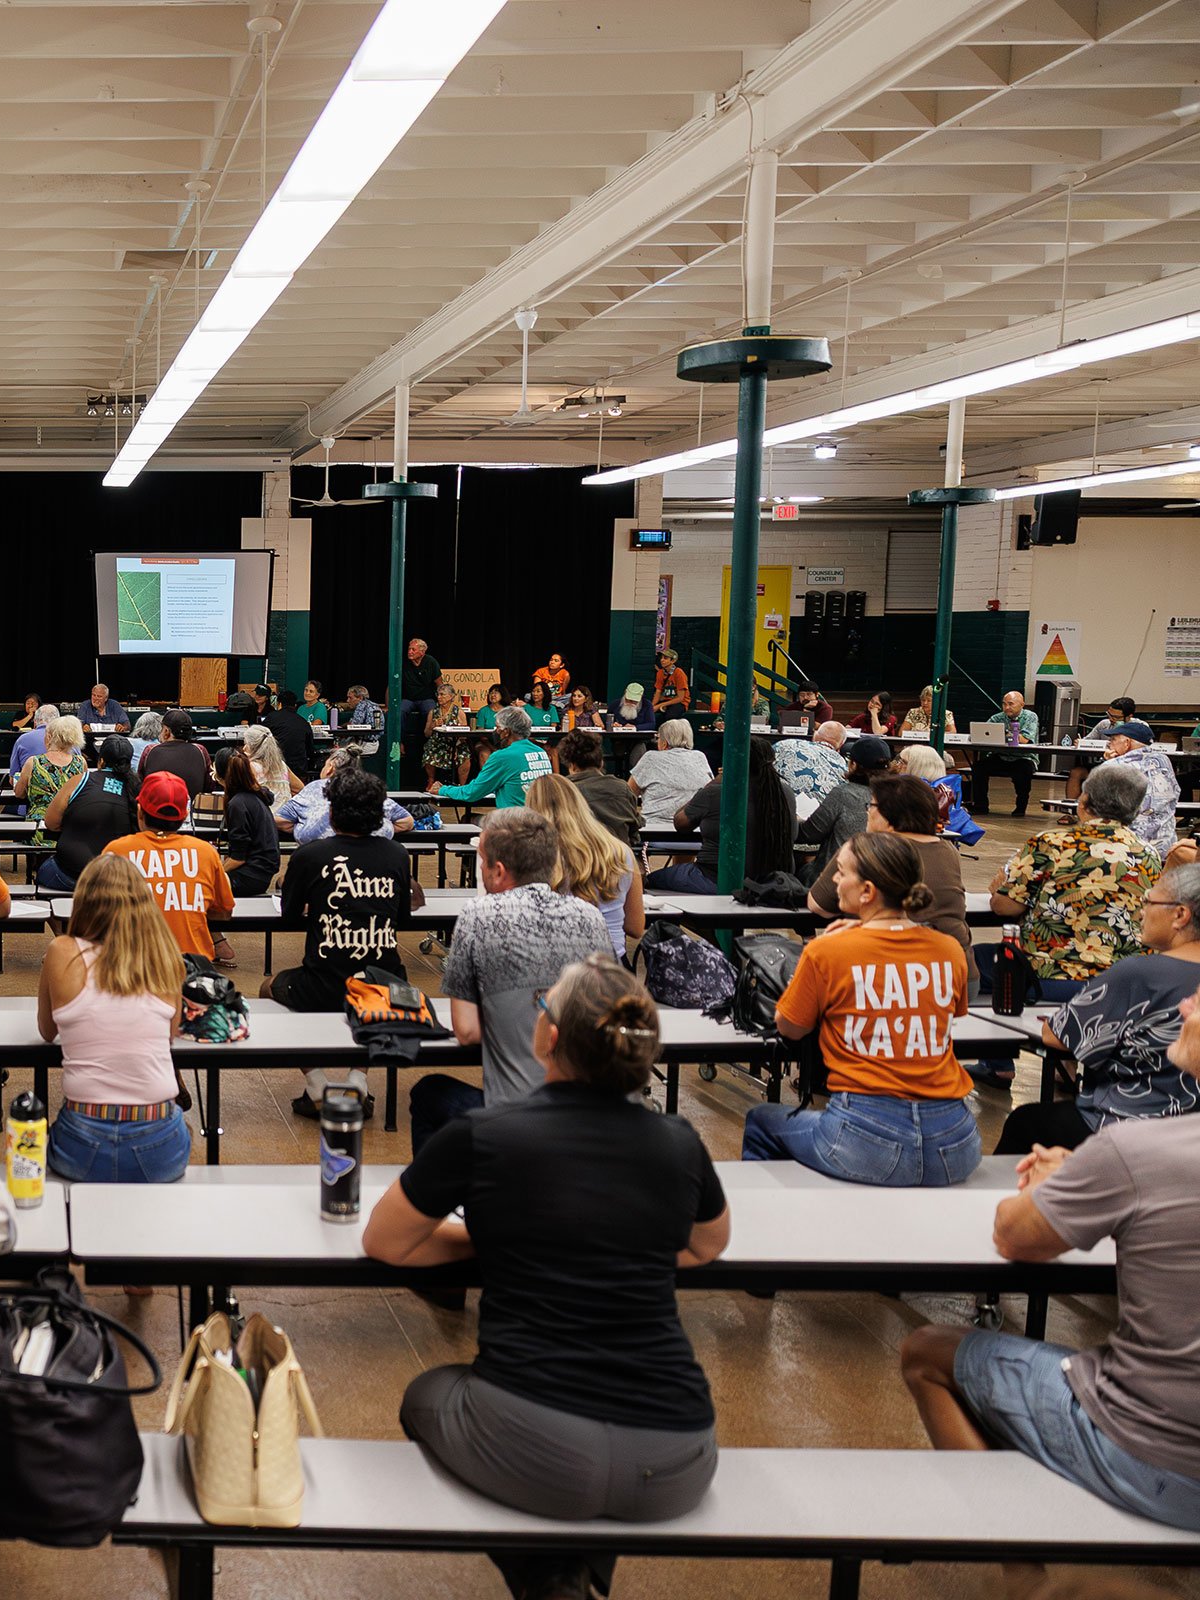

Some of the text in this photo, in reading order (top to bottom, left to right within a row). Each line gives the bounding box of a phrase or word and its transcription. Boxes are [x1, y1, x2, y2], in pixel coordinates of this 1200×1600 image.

[778, 506, 795, 519] EXIT
[454, 672, 495, 683] GONDOLA
[129, 848, 199, 878] KAPU
[319, 913, 397, 960] Rights
[851, 961, 954, 1010] KAPU
